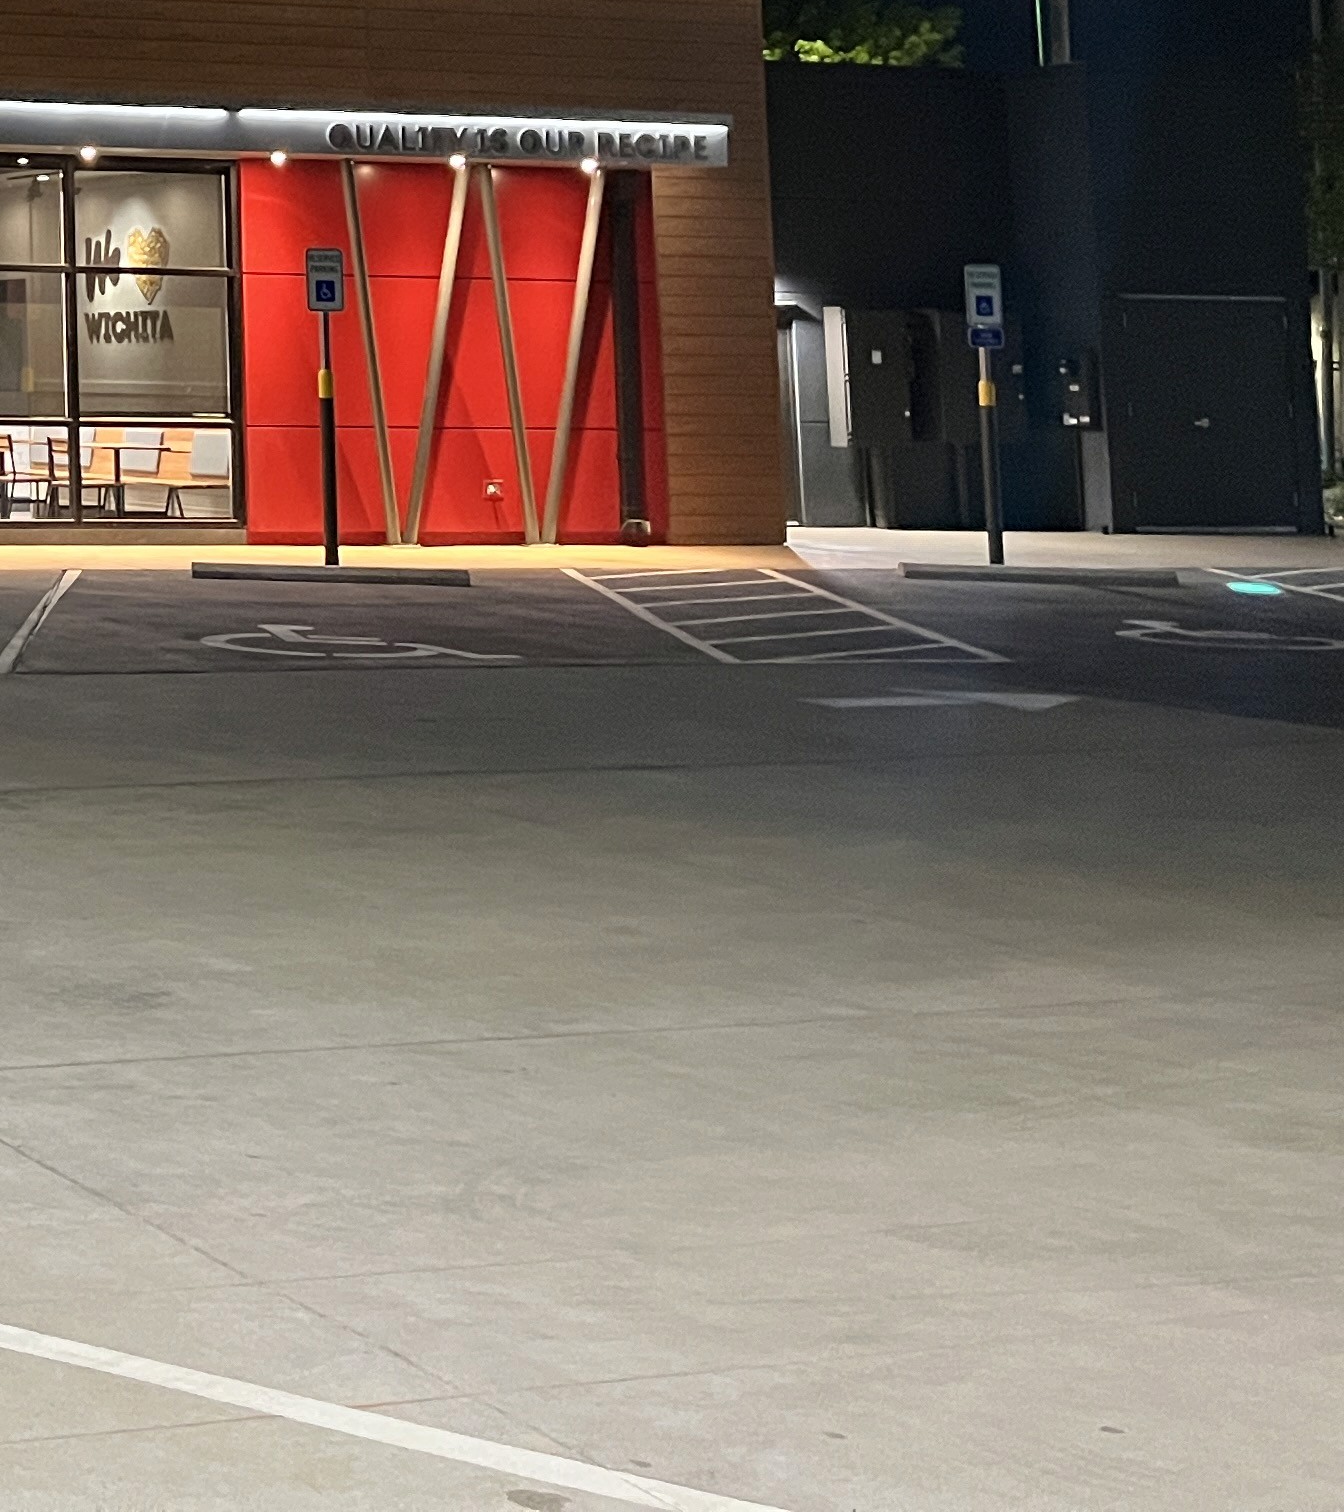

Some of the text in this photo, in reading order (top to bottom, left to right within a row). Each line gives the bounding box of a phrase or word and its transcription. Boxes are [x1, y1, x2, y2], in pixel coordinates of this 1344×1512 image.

[326, 122, 709, 160] QUALITY IS OUR RECIPE
[84, 310, 174, 344] WICHITA
